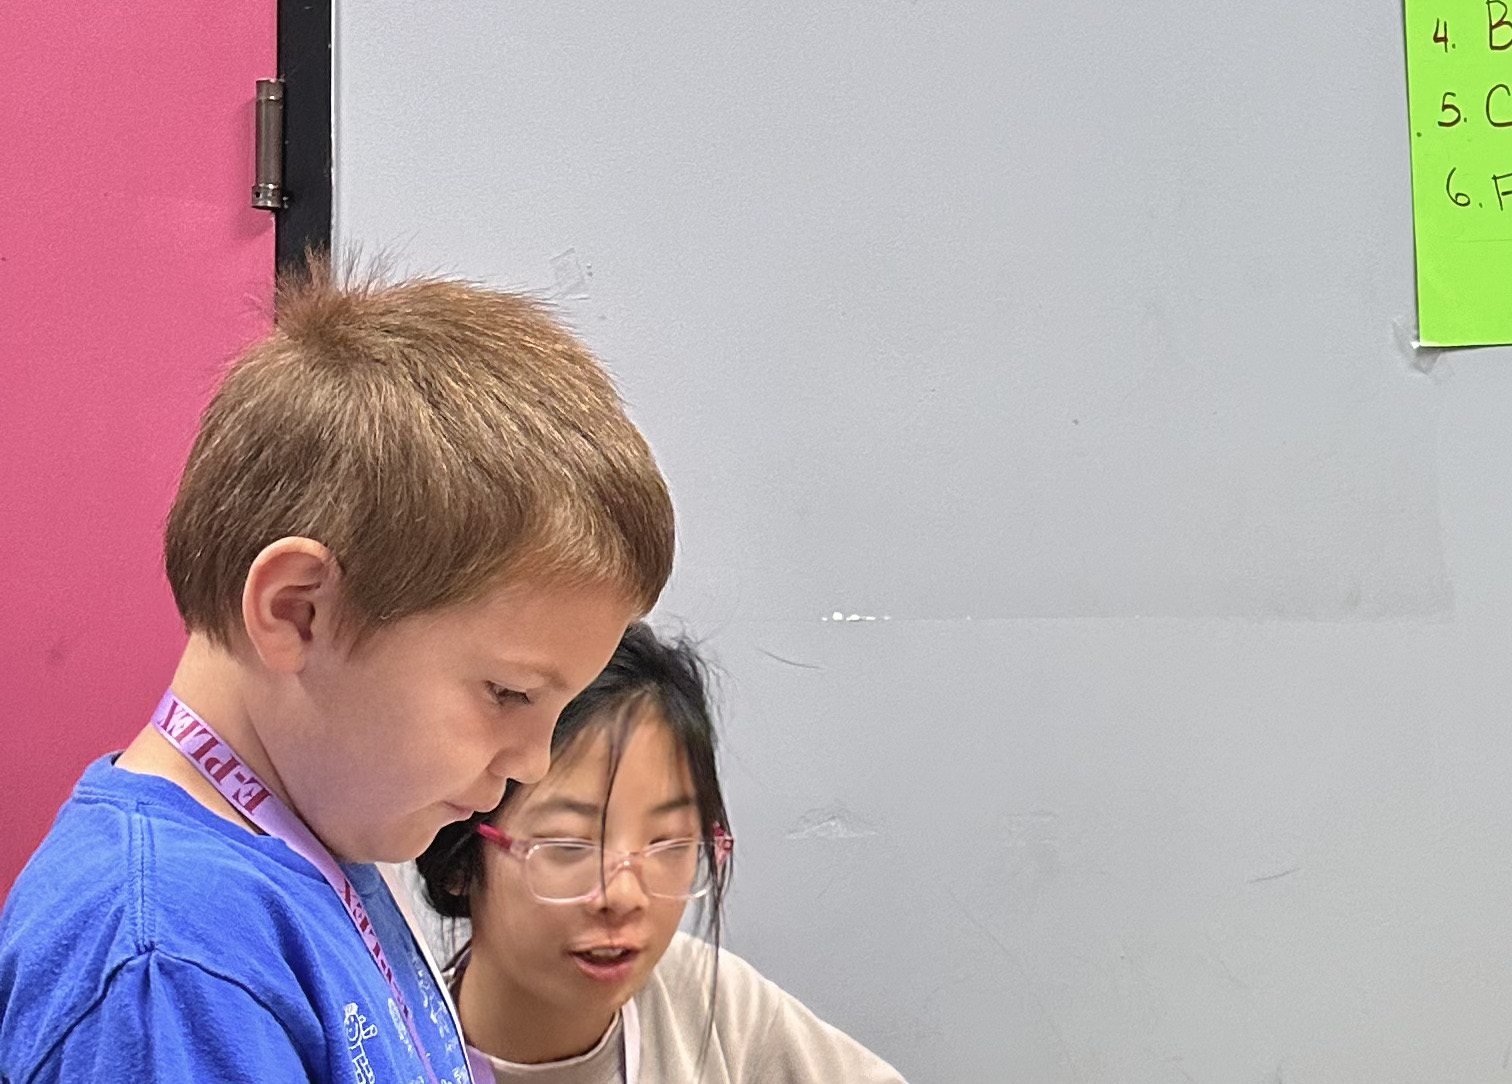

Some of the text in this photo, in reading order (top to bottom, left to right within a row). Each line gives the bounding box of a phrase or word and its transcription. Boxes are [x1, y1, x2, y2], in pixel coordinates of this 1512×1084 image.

[1433, 18, 1456, 53] 4.
[1438, 92, 1467, 127] 5.
[1446, 167, 1483, 208] 6.
[159, 699, 273, 816] E-PLEX
